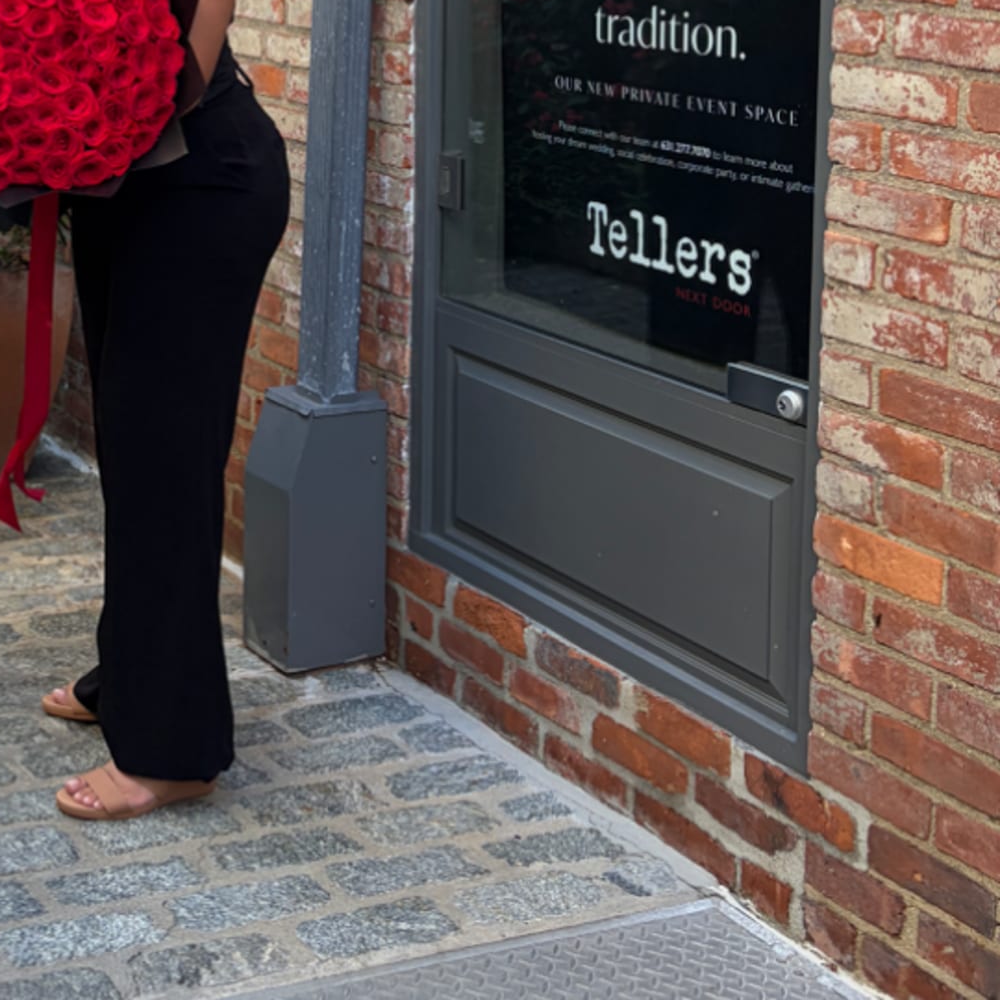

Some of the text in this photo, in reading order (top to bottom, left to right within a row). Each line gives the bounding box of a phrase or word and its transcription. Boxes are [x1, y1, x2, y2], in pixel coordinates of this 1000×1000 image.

[595, 5, 746, 61] tradition.
[554, 74, 799, 127] OUR NEW PRIVATE EVENT SPACE
[768, 160, 793, 174] about
[675, 287, 751, 317] NEXT DOOR
